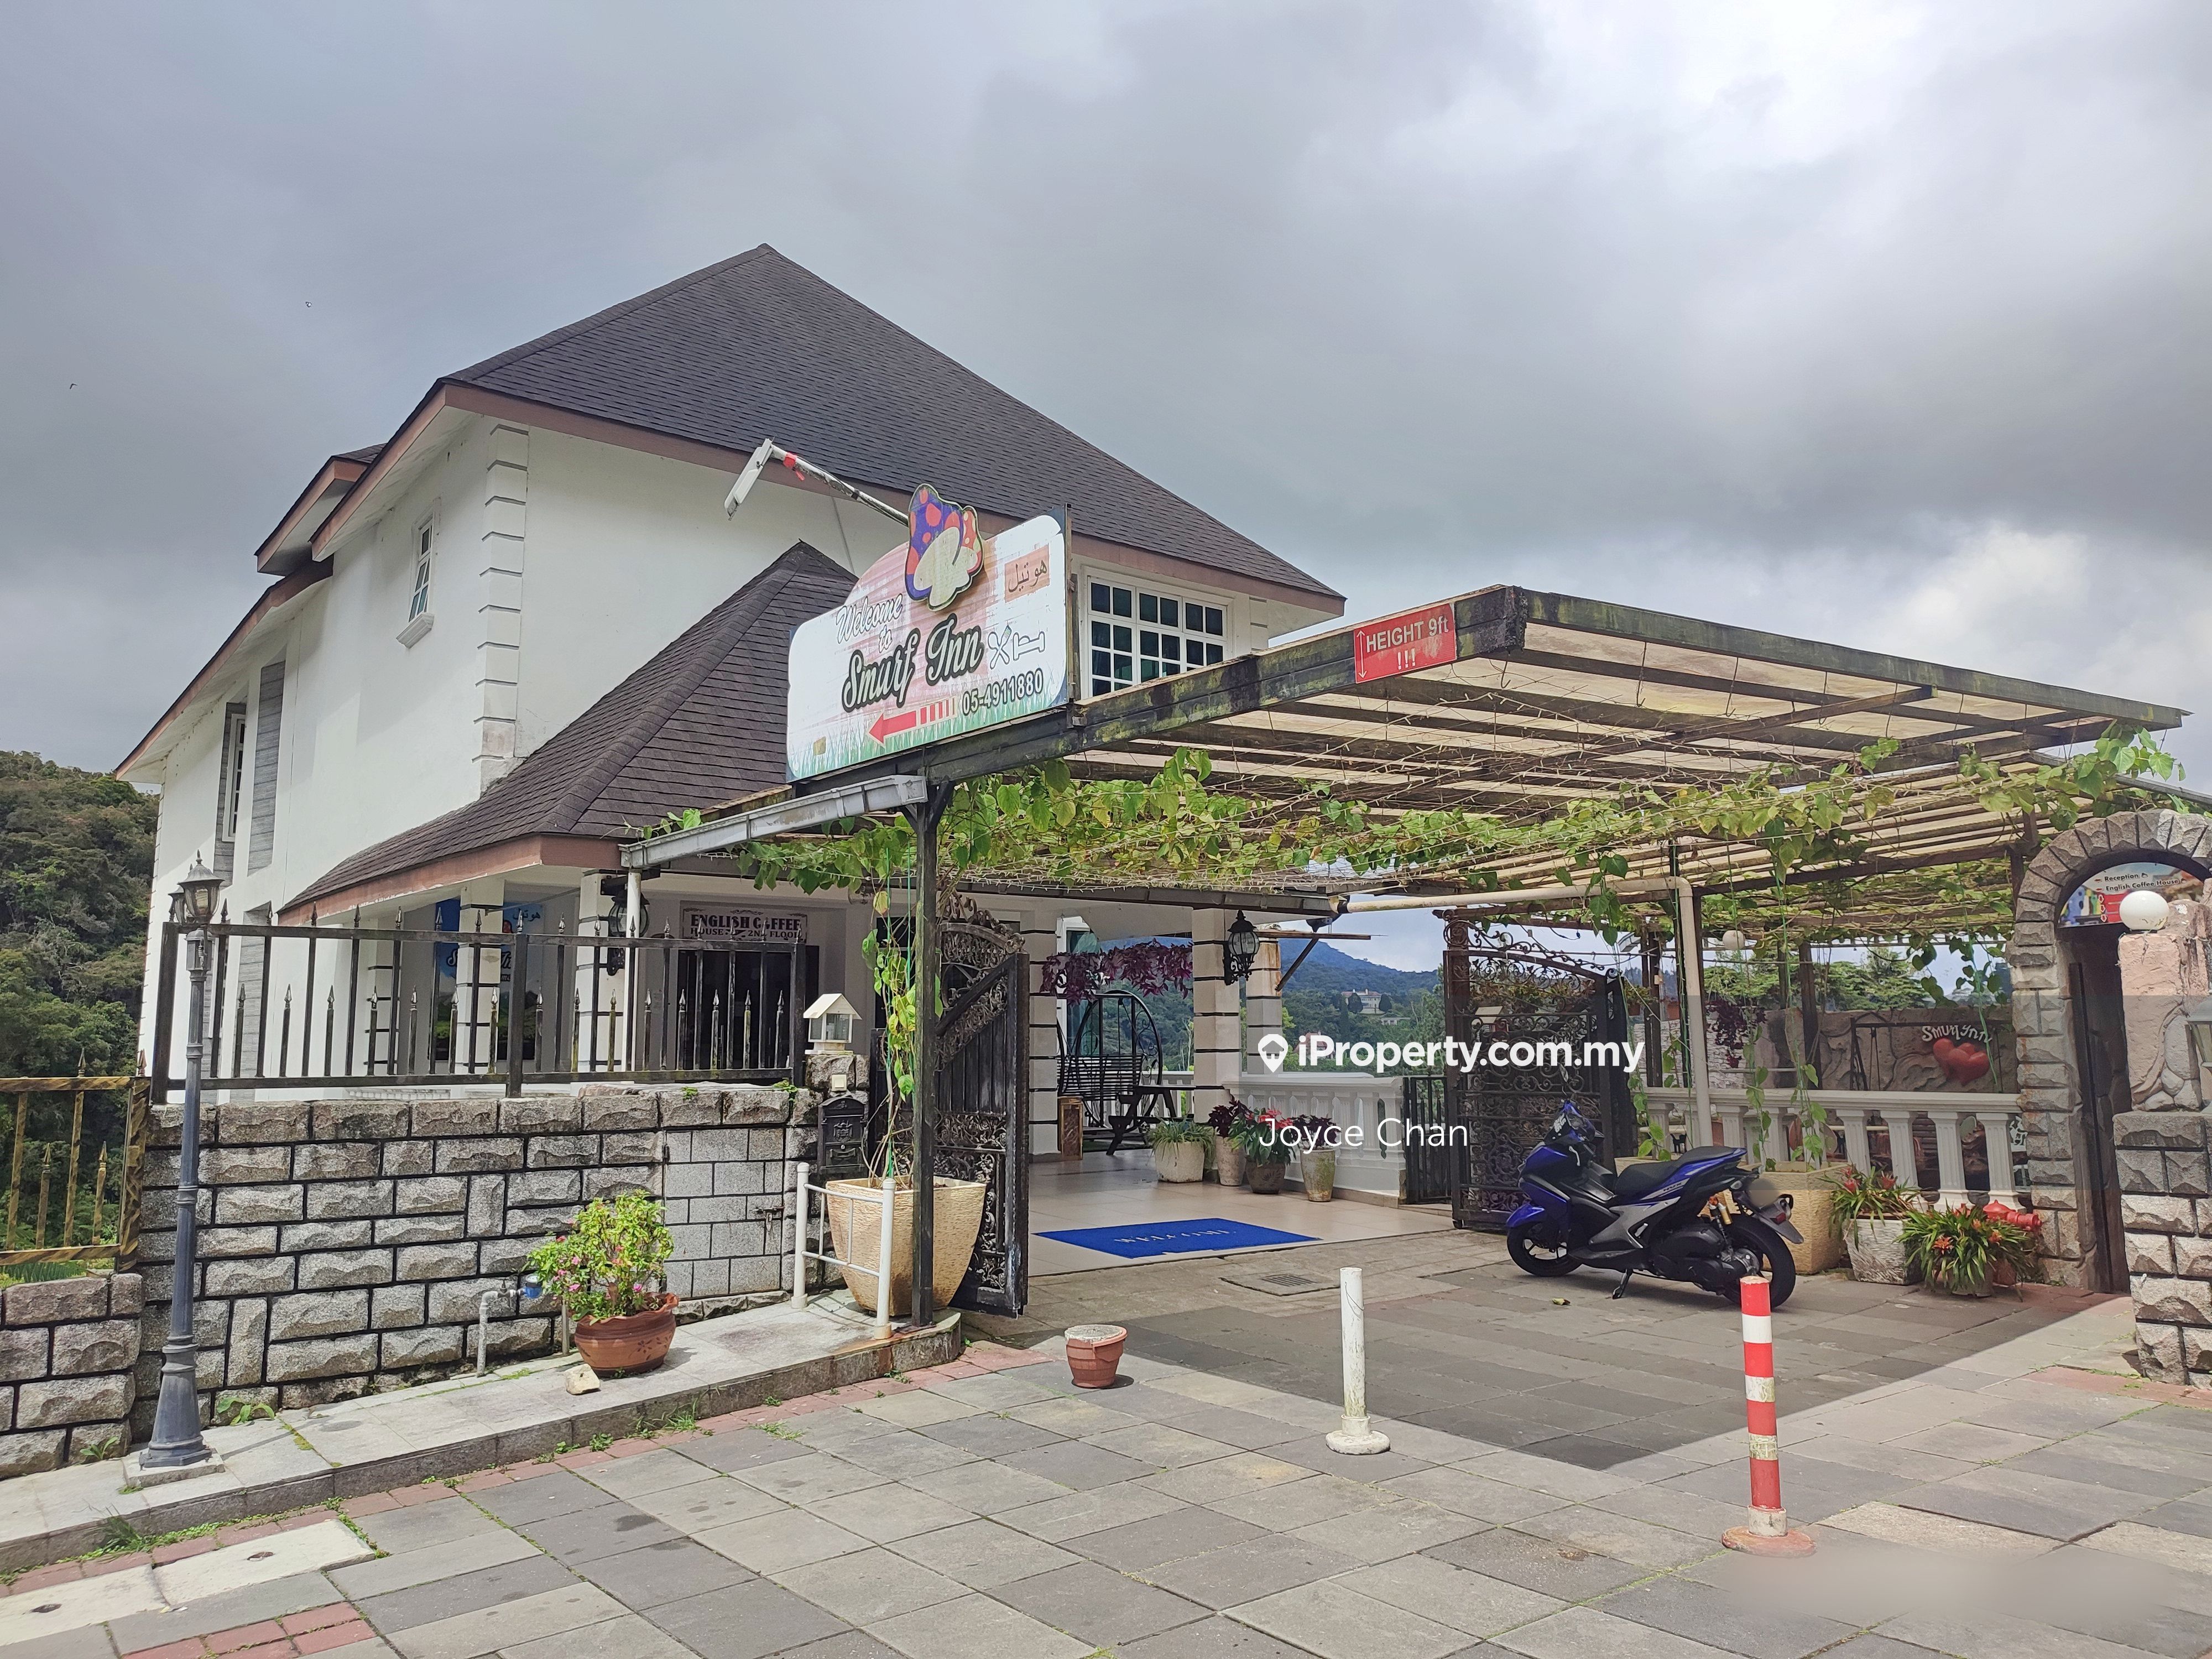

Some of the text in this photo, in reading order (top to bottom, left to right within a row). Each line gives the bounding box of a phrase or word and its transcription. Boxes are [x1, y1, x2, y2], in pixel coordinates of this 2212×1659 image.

[836, 593, 903, 644] Welcome
[1366, 615, 1449, 653] HEIGHT 9ft
[878, 624, 893, 653] to
[842, 613, 985, 712] Smurf Inn
[962, 667, 1044, 716] 05-4911880
[2105, 873, 2139, 882] Reception
[2106, 883, 2130, 892] English
[691, 914, 750, 928] ENGLISH
